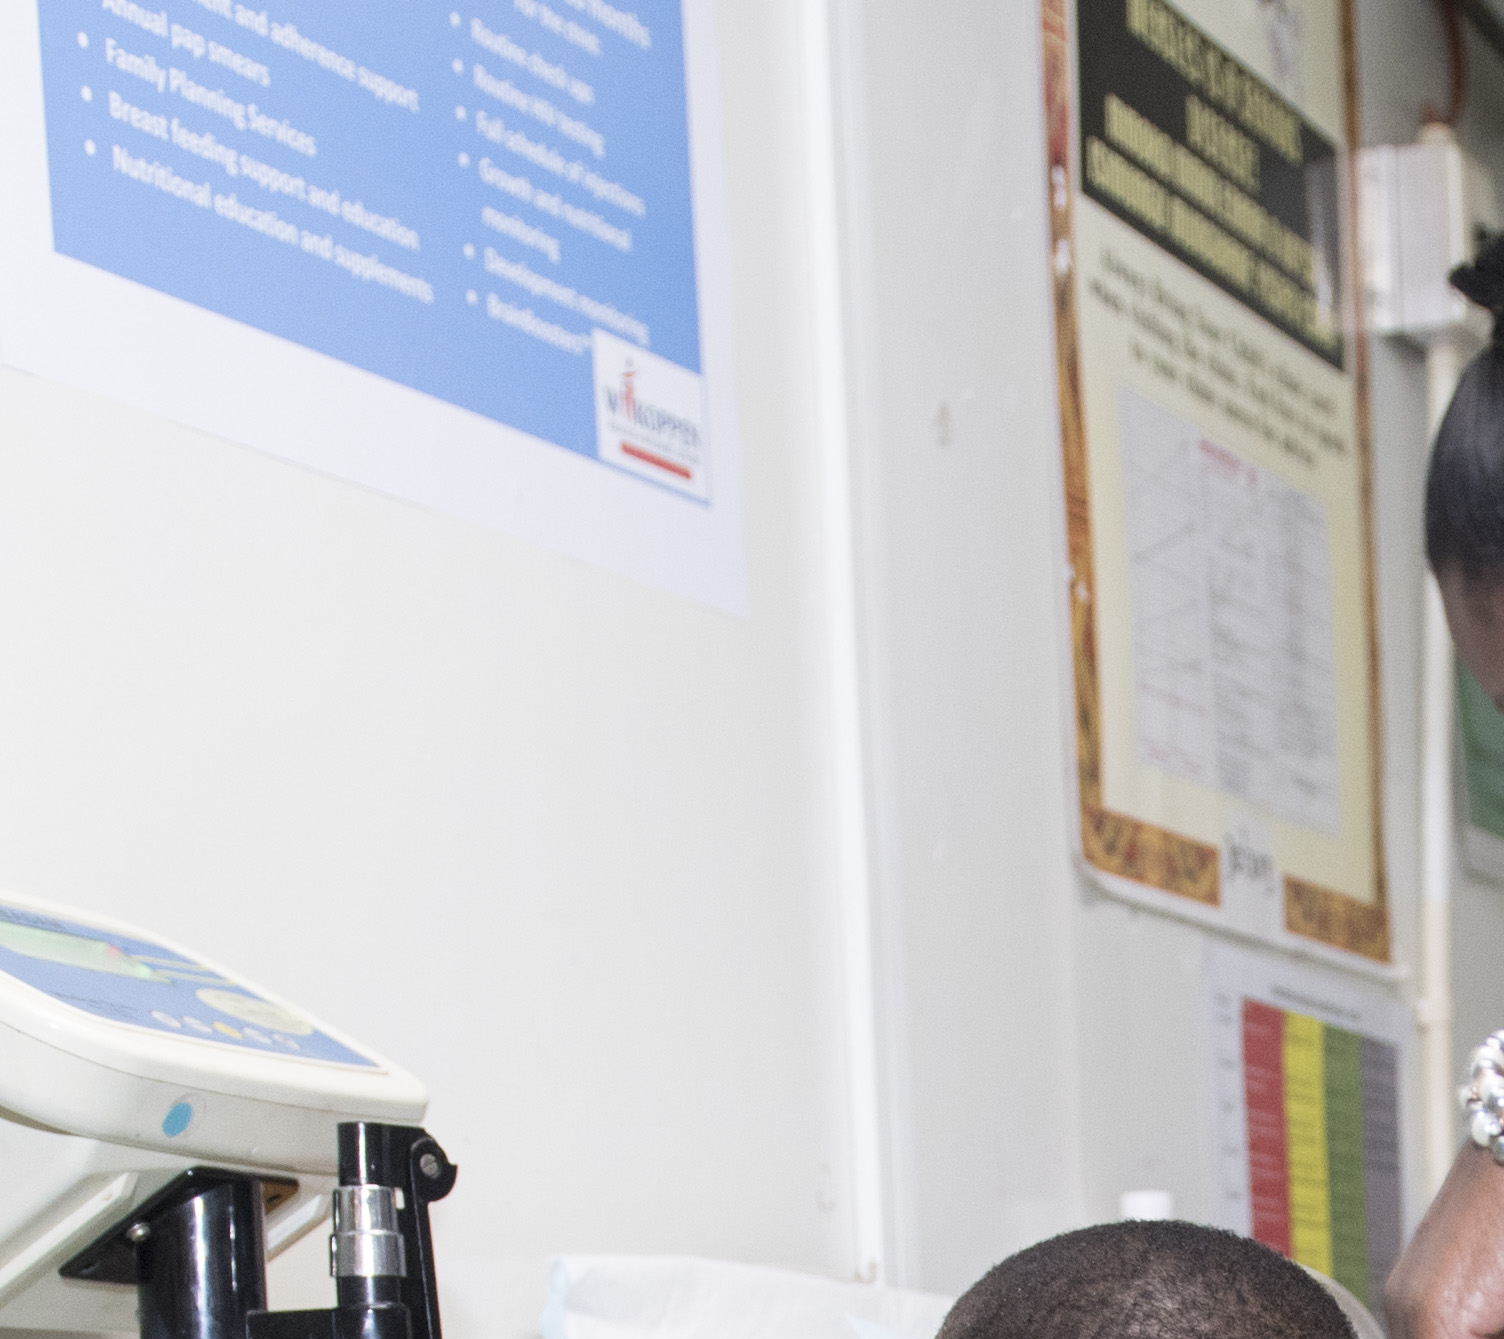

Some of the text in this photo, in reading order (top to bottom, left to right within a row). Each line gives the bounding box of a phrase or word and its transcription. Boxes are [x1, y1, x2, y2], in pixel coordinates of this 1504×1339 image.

[106, 37, 317, 157] Family Planning Services
[171, 22, 206, 59] pap
[208, 40, 271, 87] smears
[109, 90, 420, 252] Breast feeding support and education
[113, 143, 435, 305] Nutritional education and supplements
